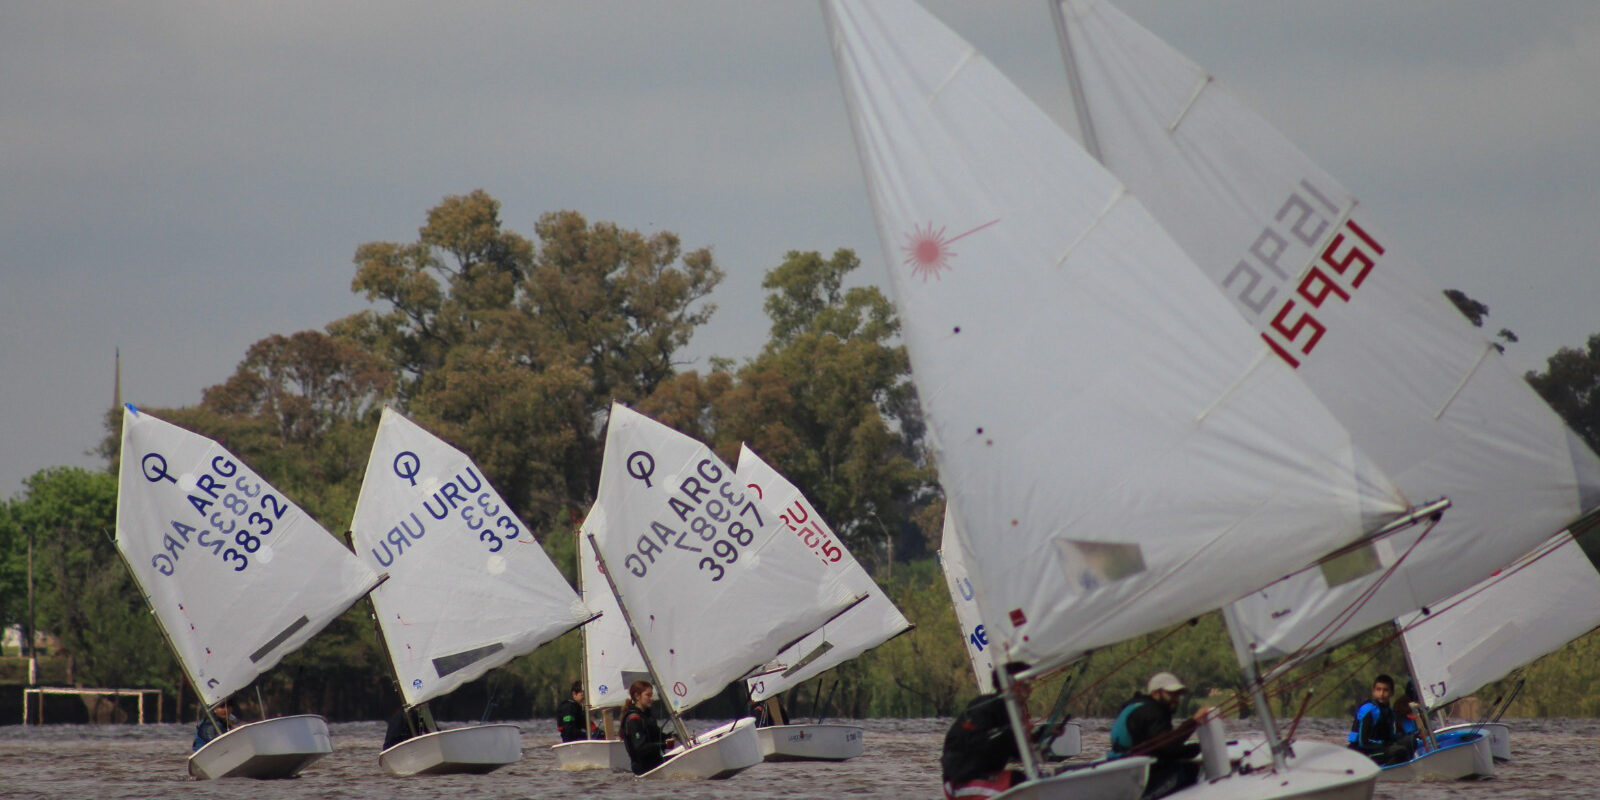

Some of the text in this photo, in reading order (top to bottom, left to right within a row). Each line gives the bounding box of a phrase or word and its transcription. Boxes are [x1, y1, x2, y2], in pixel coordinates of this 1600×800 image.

[1260, 218, 1386, 370] 15951
[187, 455, 237, 517] ARG
[422, 466, 482, 520] URU
[668, 458, 723, 522] ARG
[222, 493, 288, 572] 3832
[479, 515, 520, 553] 33
[698, 500, 764, 582] 3987
